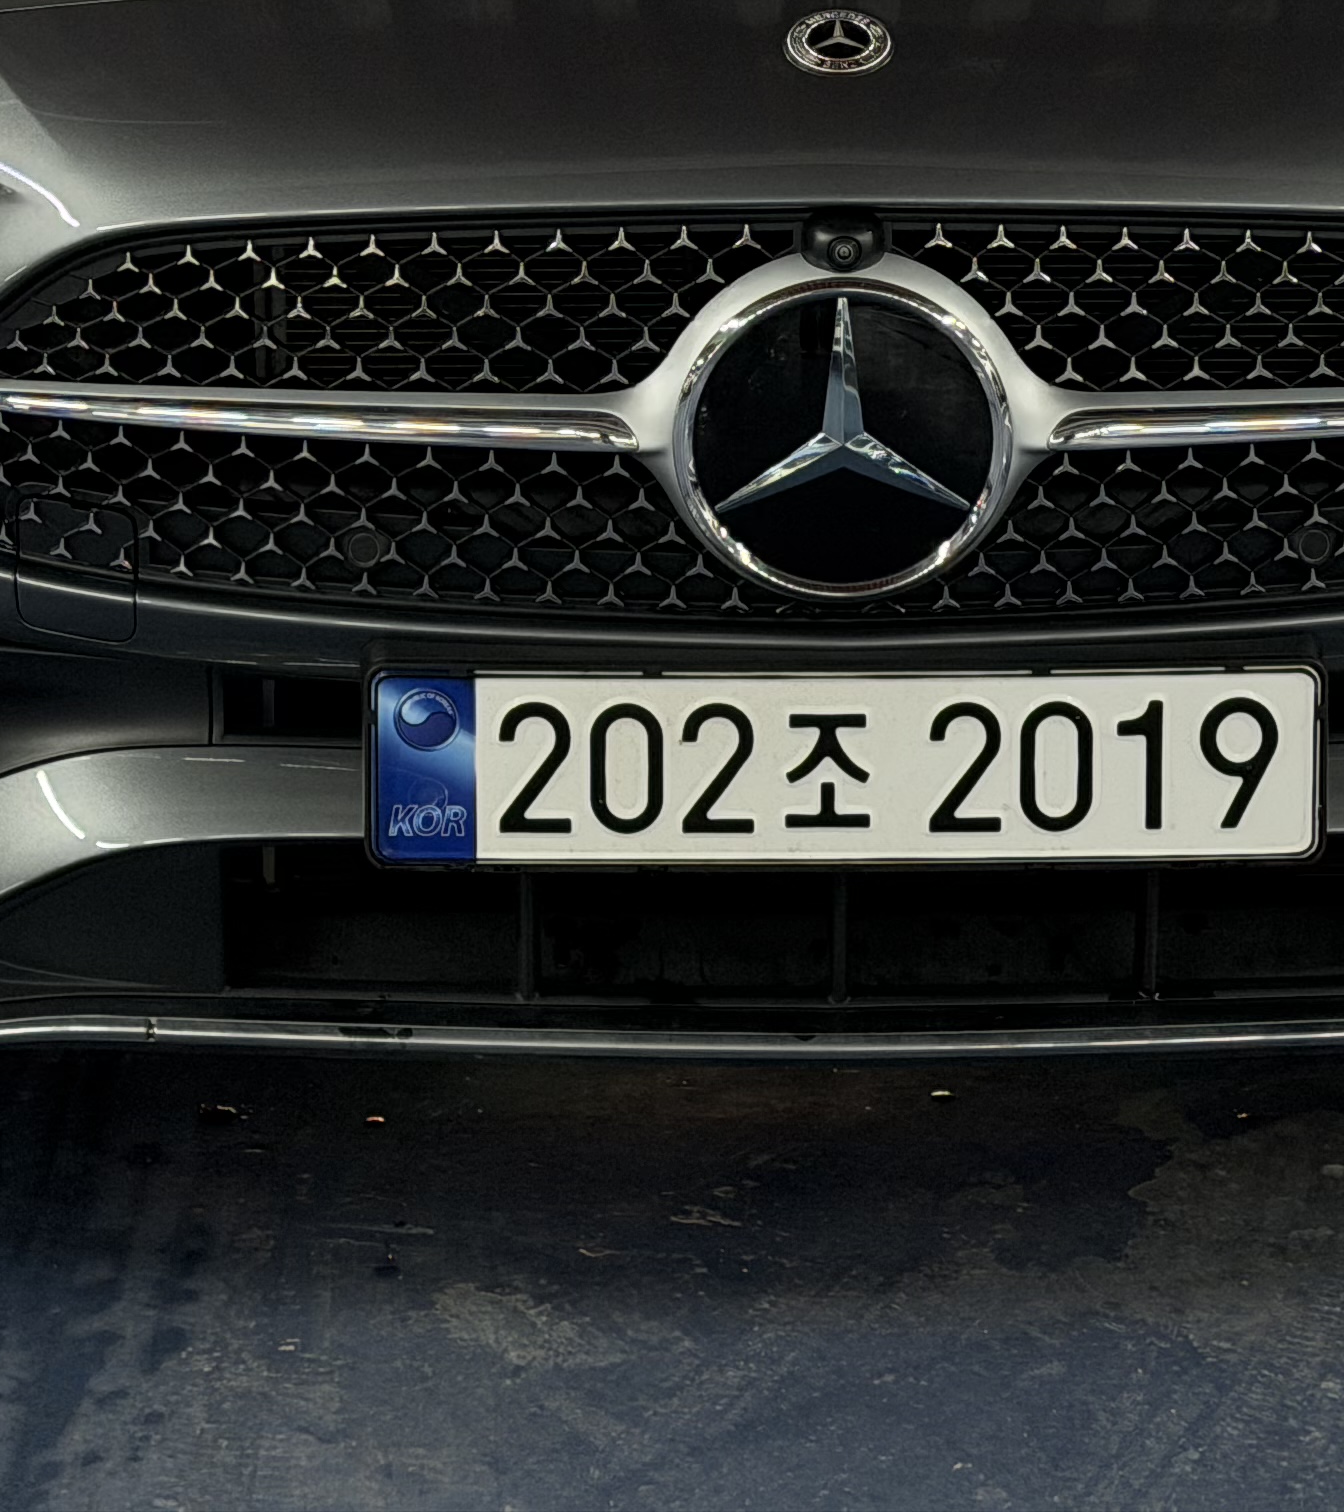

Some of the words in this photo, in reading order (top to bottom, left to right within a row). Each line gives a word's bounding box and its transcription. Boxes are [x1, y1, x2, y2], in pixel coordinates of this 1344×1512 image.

[498, 701, 871, 835] 202조
[928, 696, 1279, 833] 2019
[388, 804, 467, 837] KOR
